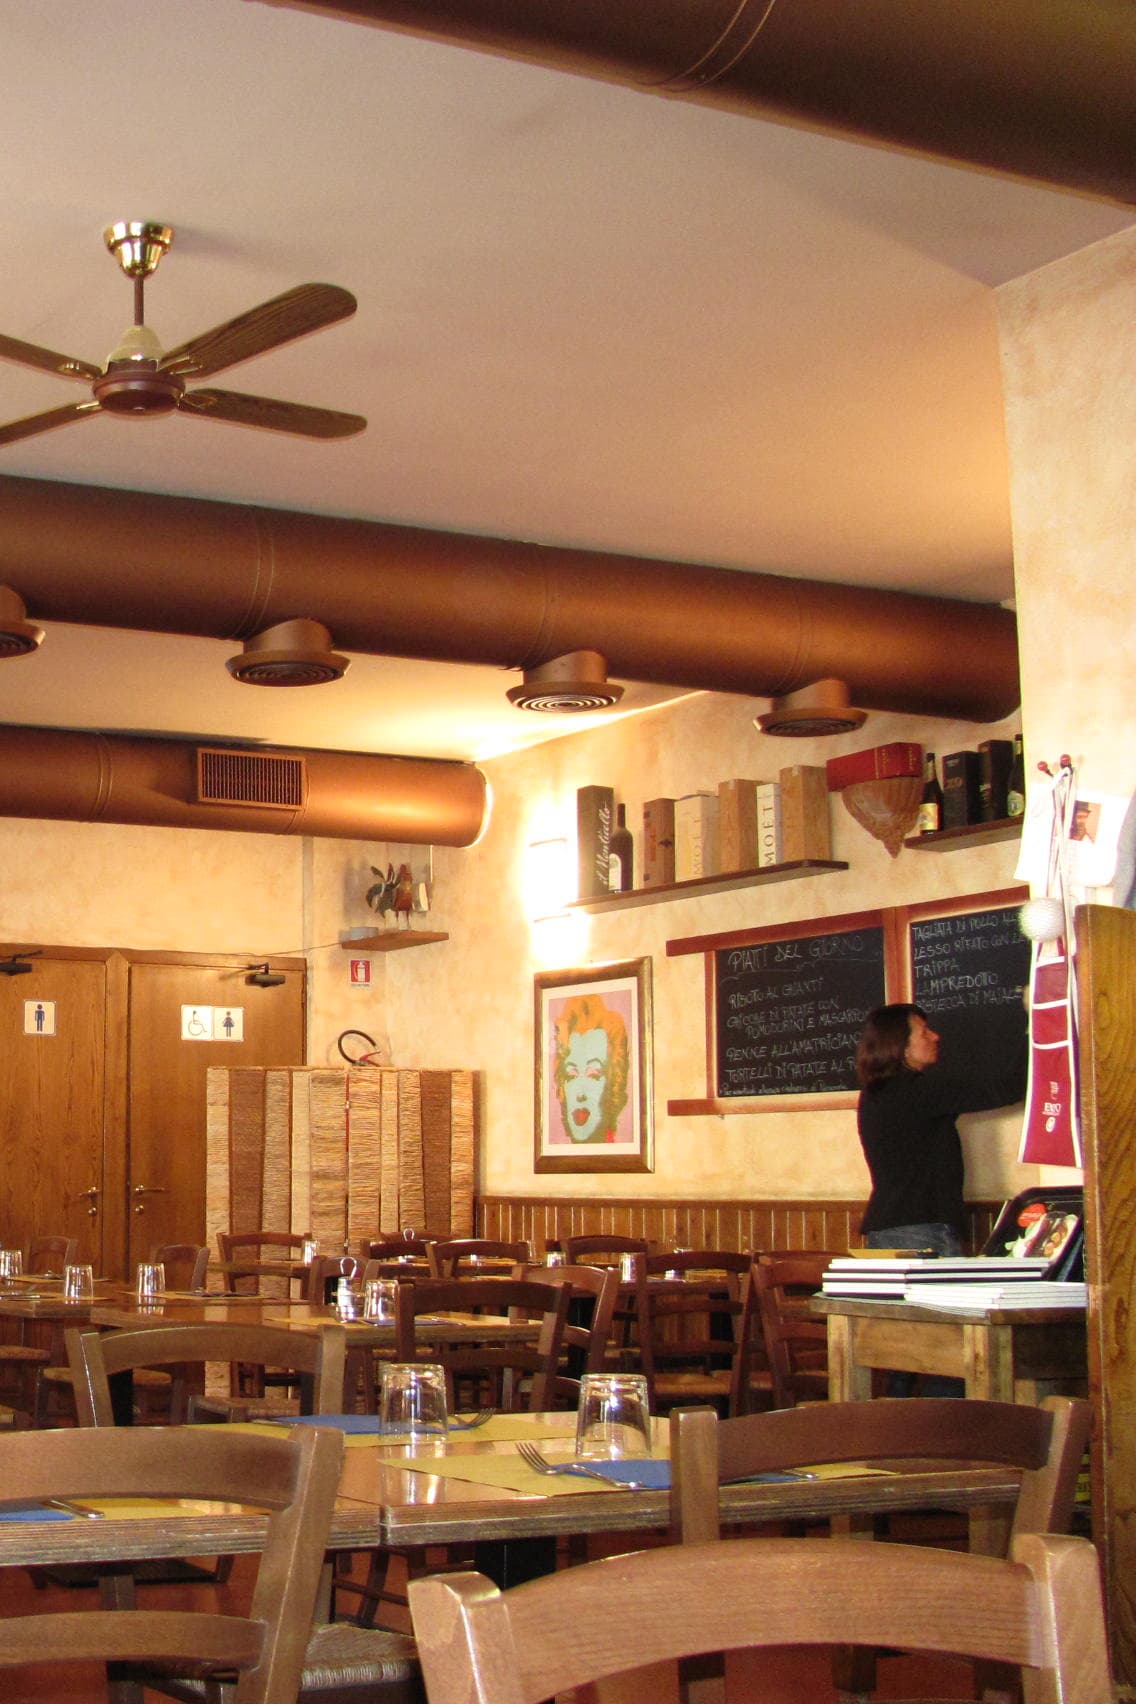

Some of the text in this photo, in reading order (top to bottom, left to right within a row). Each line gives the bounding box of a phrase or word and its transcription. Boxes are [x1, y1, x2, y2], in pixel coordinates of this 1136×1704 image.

[775, 943, 803, 962] DEL
[914, 942, 951, 960] LESSO
[914, 959, 960, 978] TRIPPA
